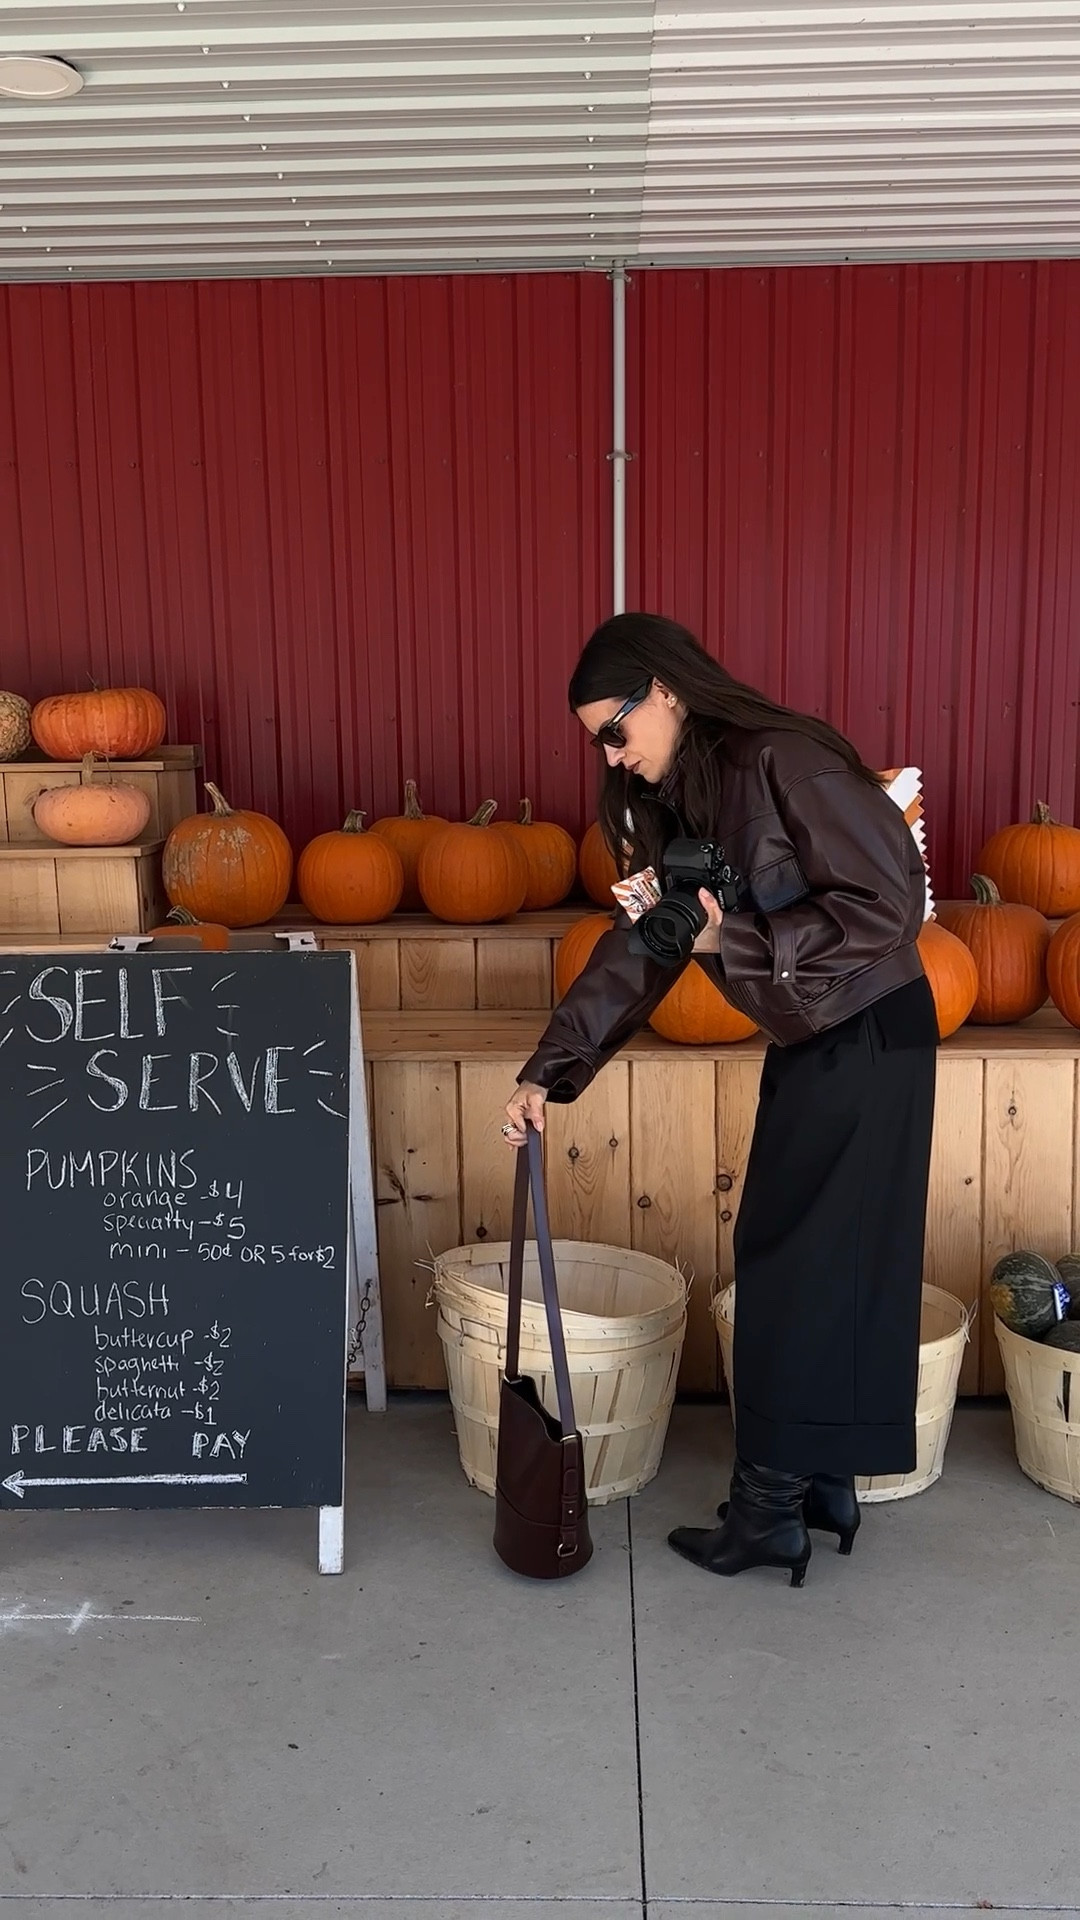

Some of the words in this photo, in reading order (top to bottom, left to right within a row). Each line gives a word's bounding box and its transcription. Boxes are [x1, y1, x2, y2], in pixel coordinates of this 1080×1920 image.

[26, 967, 192, 1043] SELF
[86, 1046, 296, 1115] SERVE
[26, 1149, 198, 1190] PUMPKINS
[103, 1190, 188, 1216] orange
[103, 1209, 194, 1240] specialty
[109, 1242, 167, 1259] mini
[240, 1244, 266, 1264] OR
[271, 1245, 286, 1263] 5
[20, 1278, 169, 1324] SQUASH
[95, 1325, 194, 1354] buttercup
[95, 1355, 179, 1382] spaghetti
[97, 1377, 185, 1402] butternut
[95, 1401, 171, 1421] delicata
[10, 1425, 149, 1455] PLEASE
[191, 1429, 251, 1459] PAY
